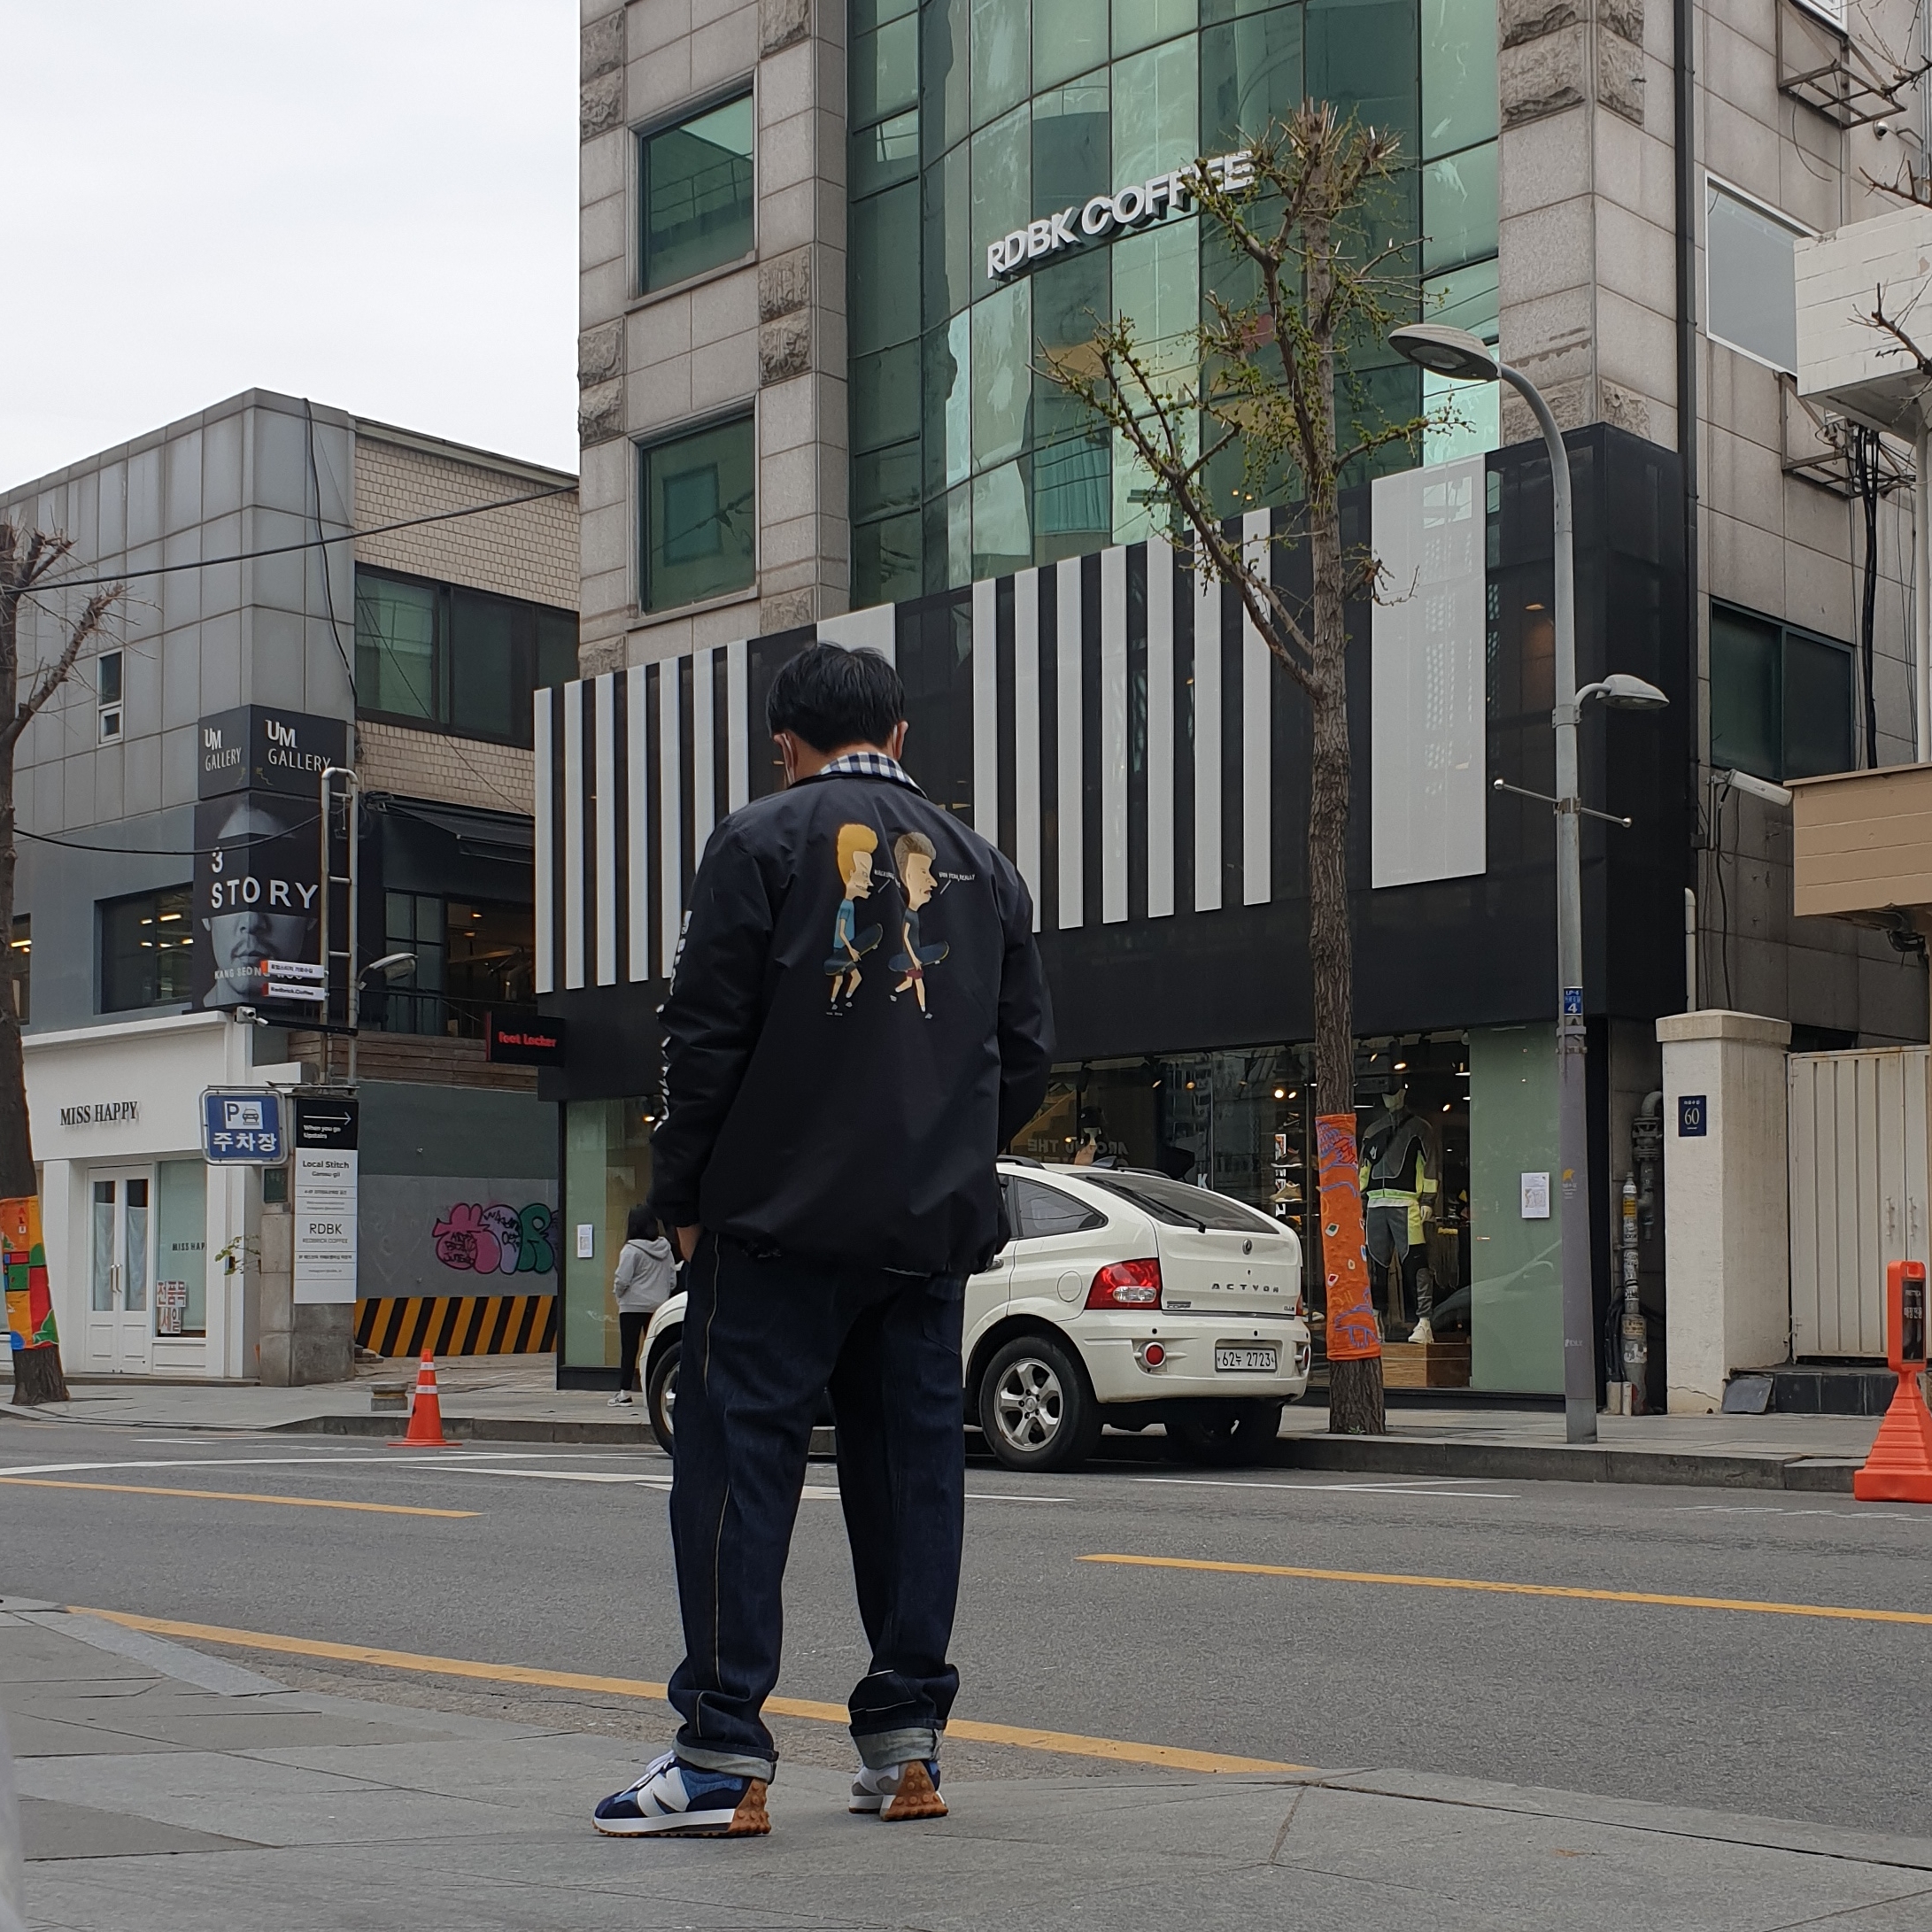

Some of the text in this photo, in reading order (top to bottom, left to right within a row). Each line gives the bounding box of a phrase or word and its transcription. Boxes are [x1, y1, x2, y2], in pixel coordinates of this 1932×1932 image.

[987, 206, 1083, 280] RDBK
[205, 747, 242, 771] GALLERY
[268, 748, 331, 772] GALLERY
[212, 846, 223, 873] 3
[212, 877, 319, 908] STORY
[214, 969, 235, 979] KANG
[1567, 1002, 1578, 1014] 4
[498, 1032, 557, 1047] Foot Locker
[59, 1101, 138, 1125] MISS HAPPY
[227, 1102, 240, 1122] P
[1684, 1108, 1700, 1124] 60
[213, 1132, 277, 1152] 주차장
[309, 1223, 343, 1235] RDBK
[172, 1242, 189, 1251] MISS
[1246, 1351, 1271, 1367] 2723
